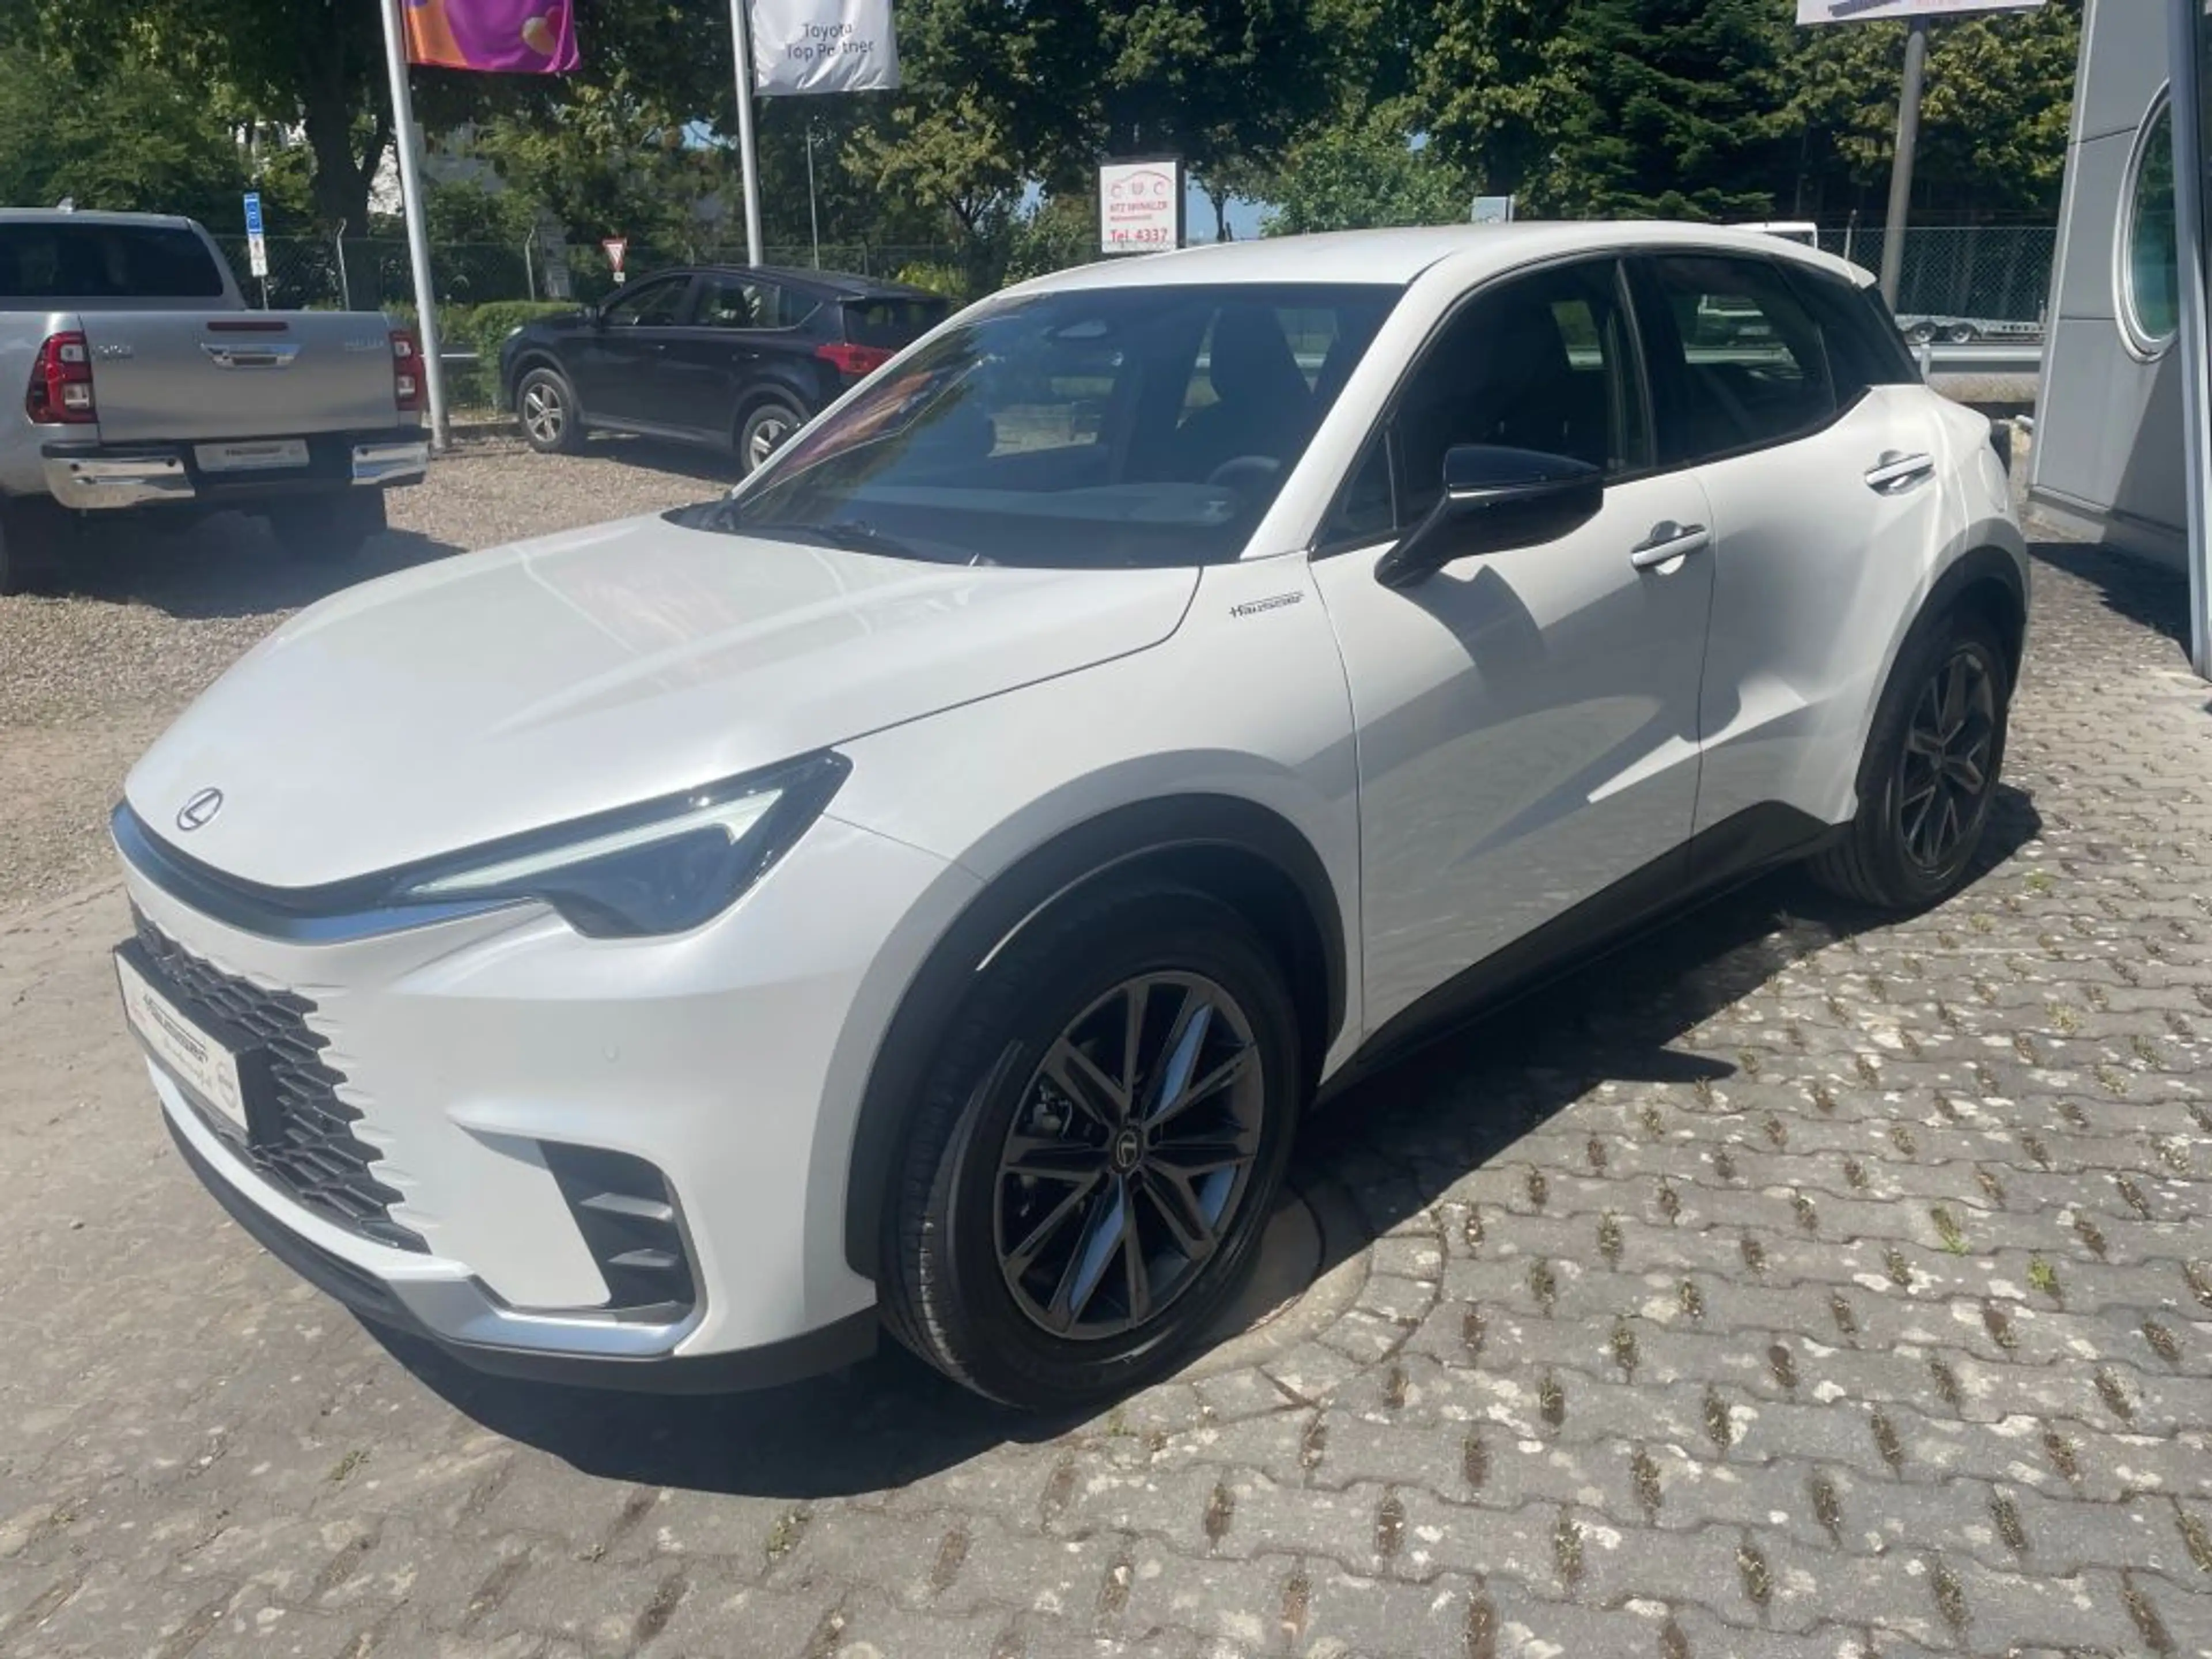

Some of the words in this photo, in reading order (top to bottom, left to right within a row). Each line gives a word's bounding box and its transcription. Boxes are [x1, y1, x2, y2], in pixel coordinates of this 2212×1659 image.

[802, 22, 852, 41] Toyota
[787, 43, 813, 60] Top
[818, 40, 874, 59] Patner
